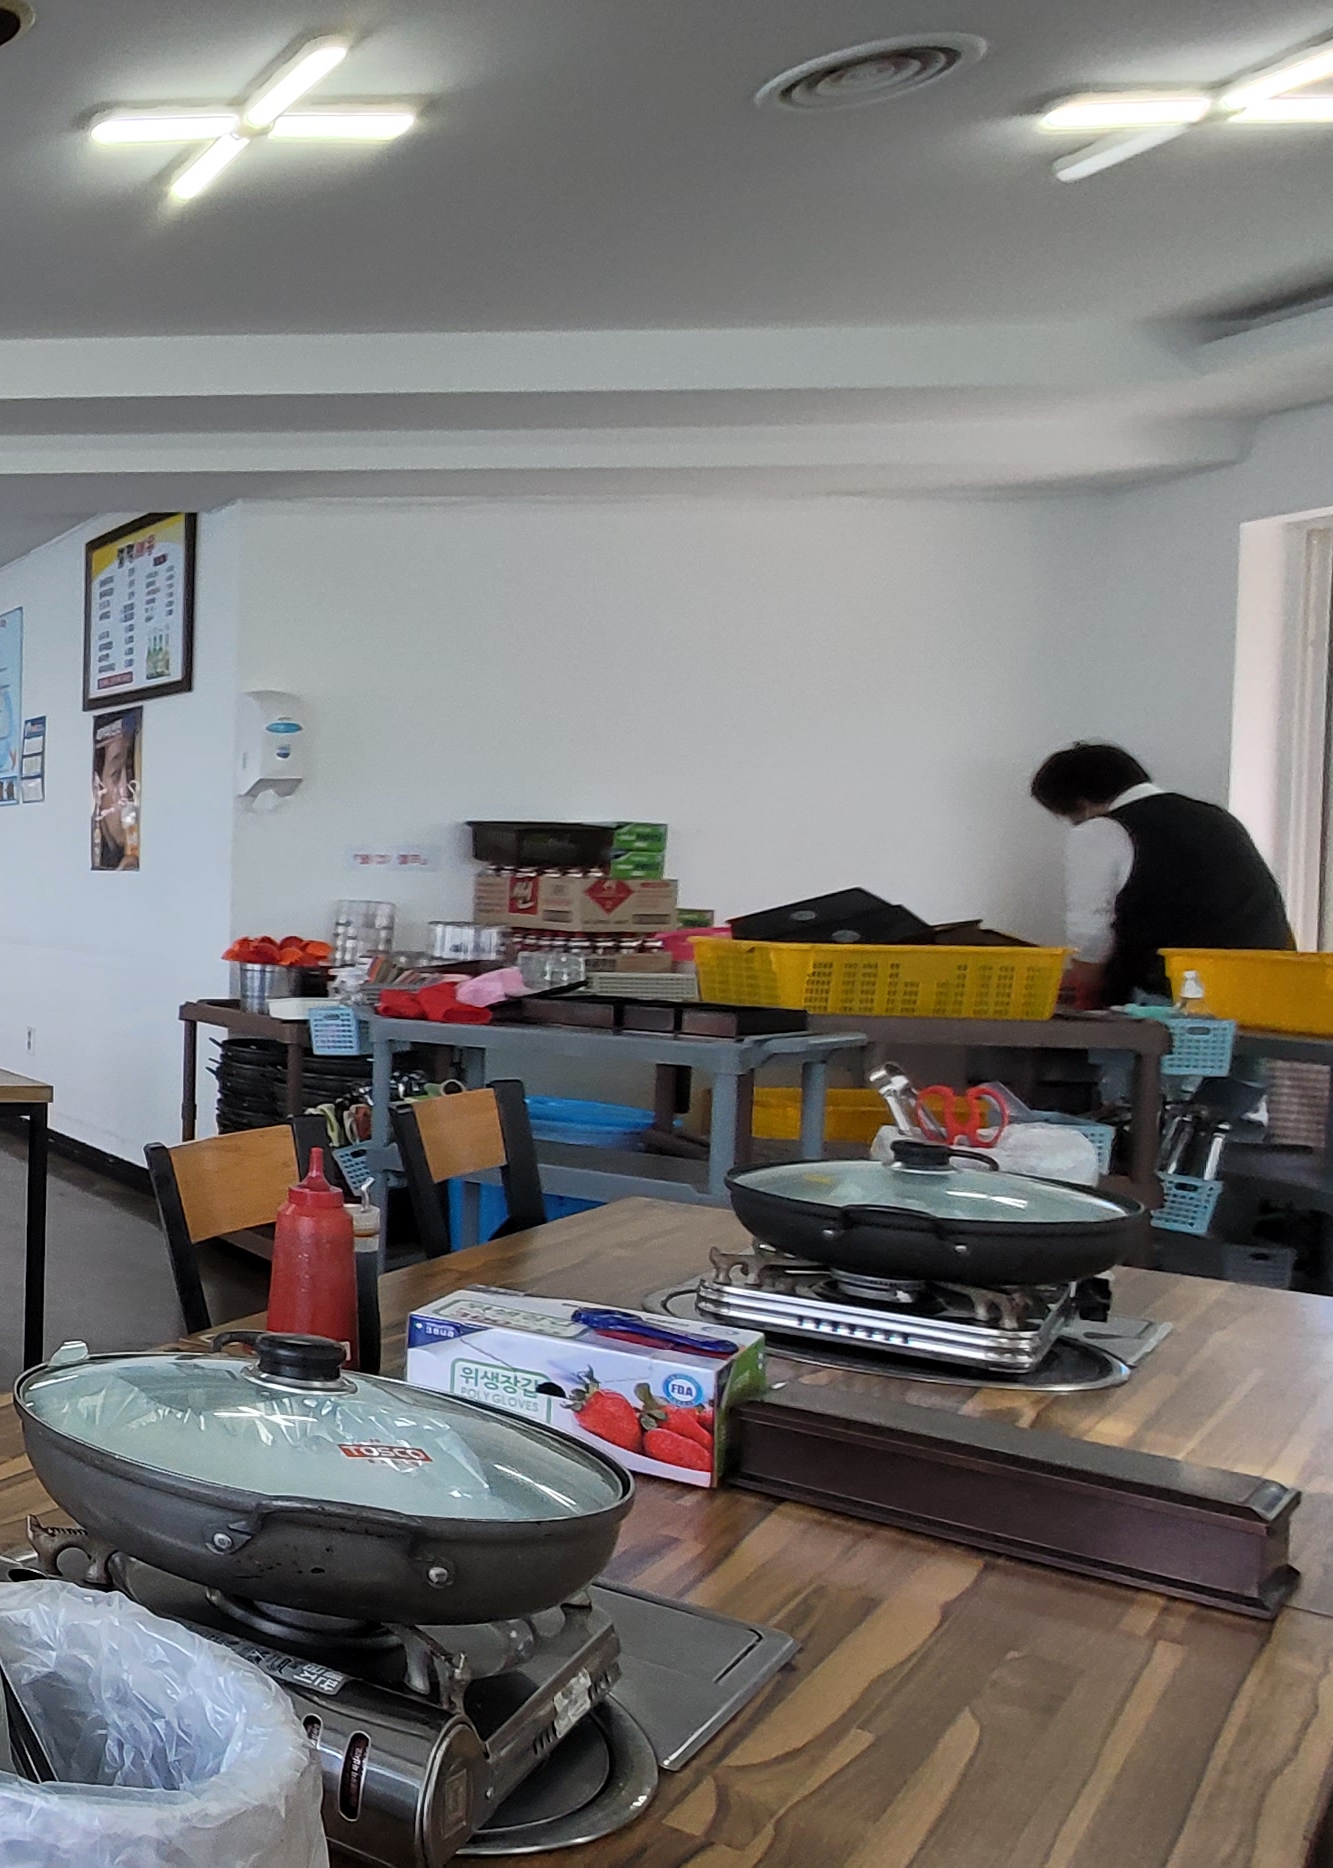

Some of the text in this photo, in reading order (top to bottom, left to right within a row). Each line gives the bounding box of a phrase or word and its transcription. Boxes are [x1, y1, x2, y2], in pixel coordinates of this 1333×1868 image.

[459, 1366, 539, 1399] 위생장갑
[671, 1383, 693, 1397] FDA
[460, 1386, 540, 1413] POLY GLOVES
[340, 1445, 427, 1460] TOSCO
